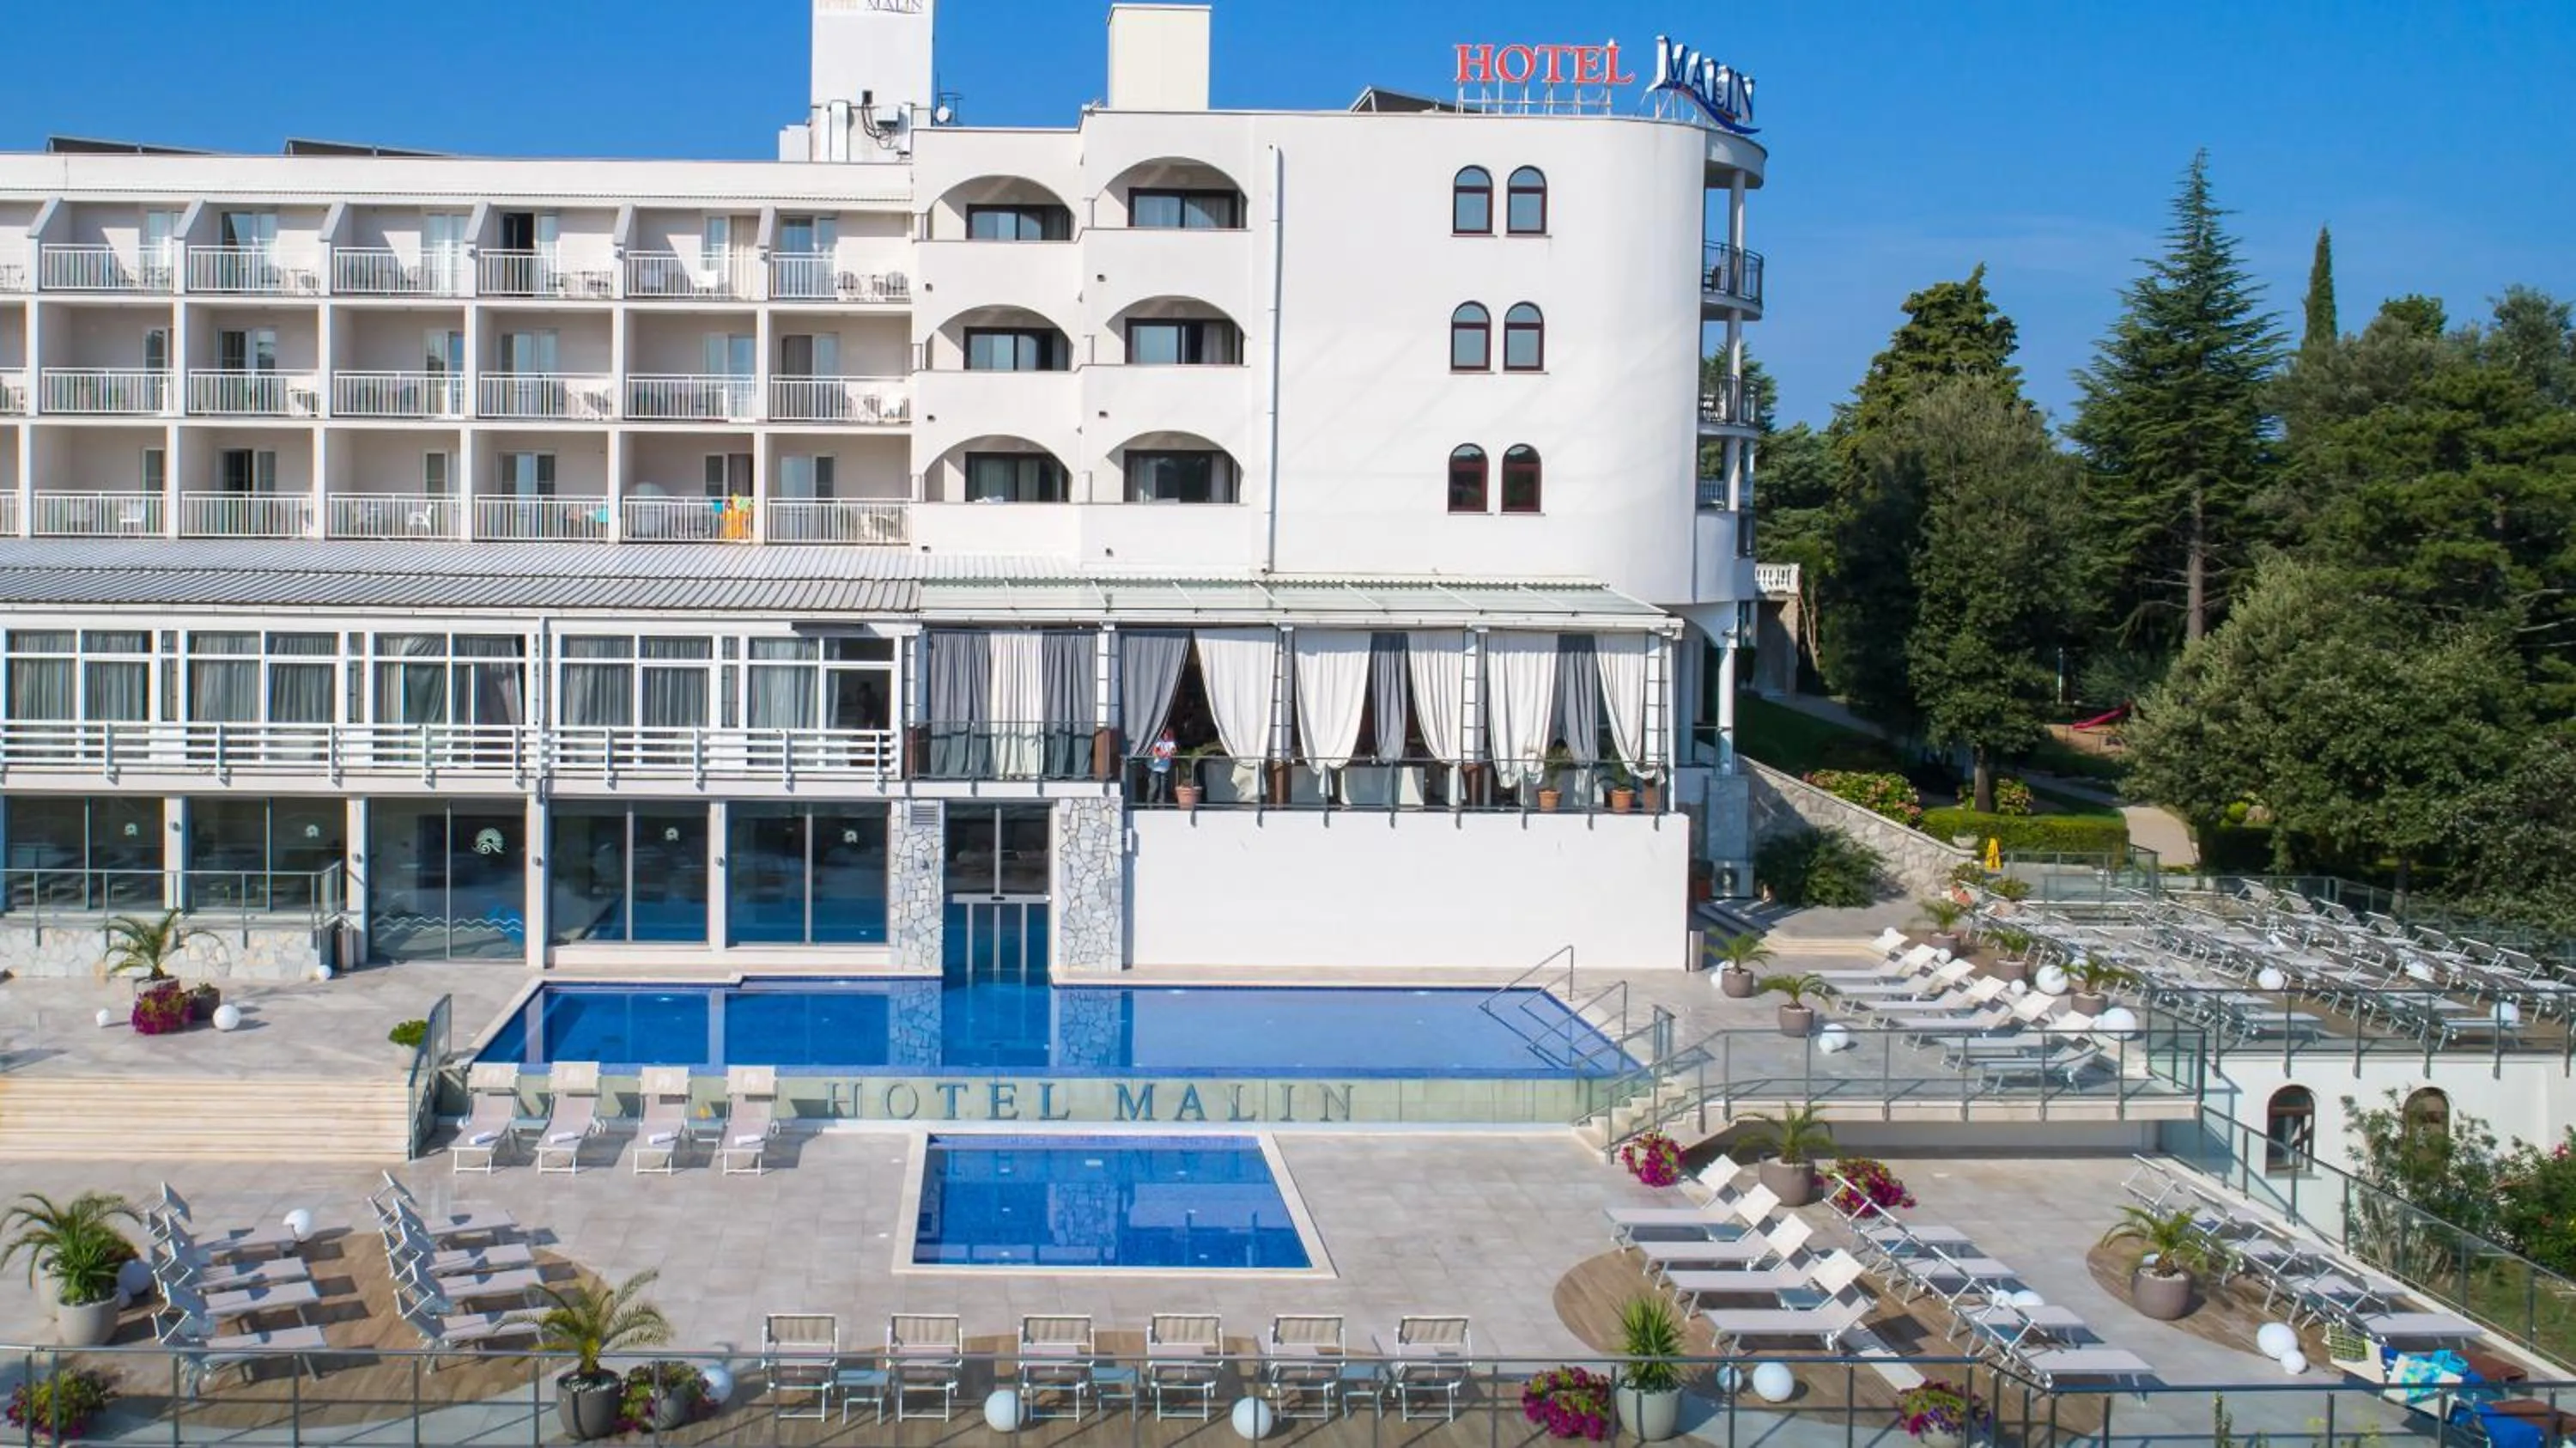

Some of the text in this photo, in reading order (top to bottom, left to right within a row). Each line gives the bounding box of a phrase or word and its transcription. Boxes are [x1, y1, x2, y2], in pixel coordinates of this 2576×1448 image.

[1454, 35, 1756, 123] HOTEL MALIN
[823, 1082, 1354, 1122] HOTEL MALIN
